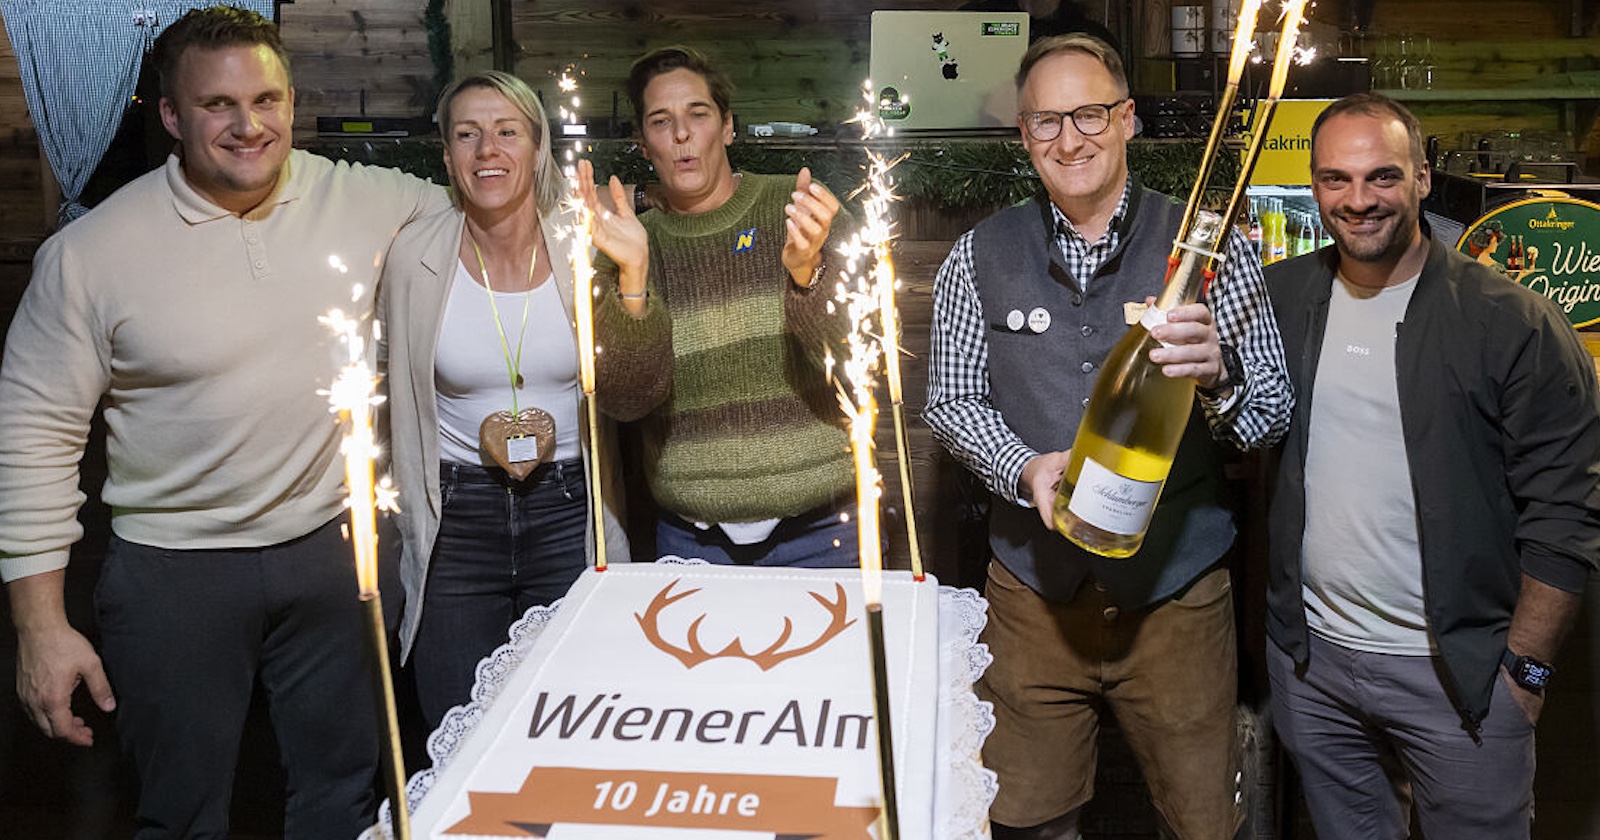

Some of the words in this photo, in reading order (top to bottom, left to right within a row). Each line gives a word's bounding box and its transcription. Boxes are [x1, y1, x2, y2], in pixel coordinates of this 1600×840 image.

[1242, 133, 1312, 151] Otakrin
[1529, 219, 1575, 231] Ottakringer
[593, 781, 638, 811] 10
[645, 782, 760, 817] Jahre
